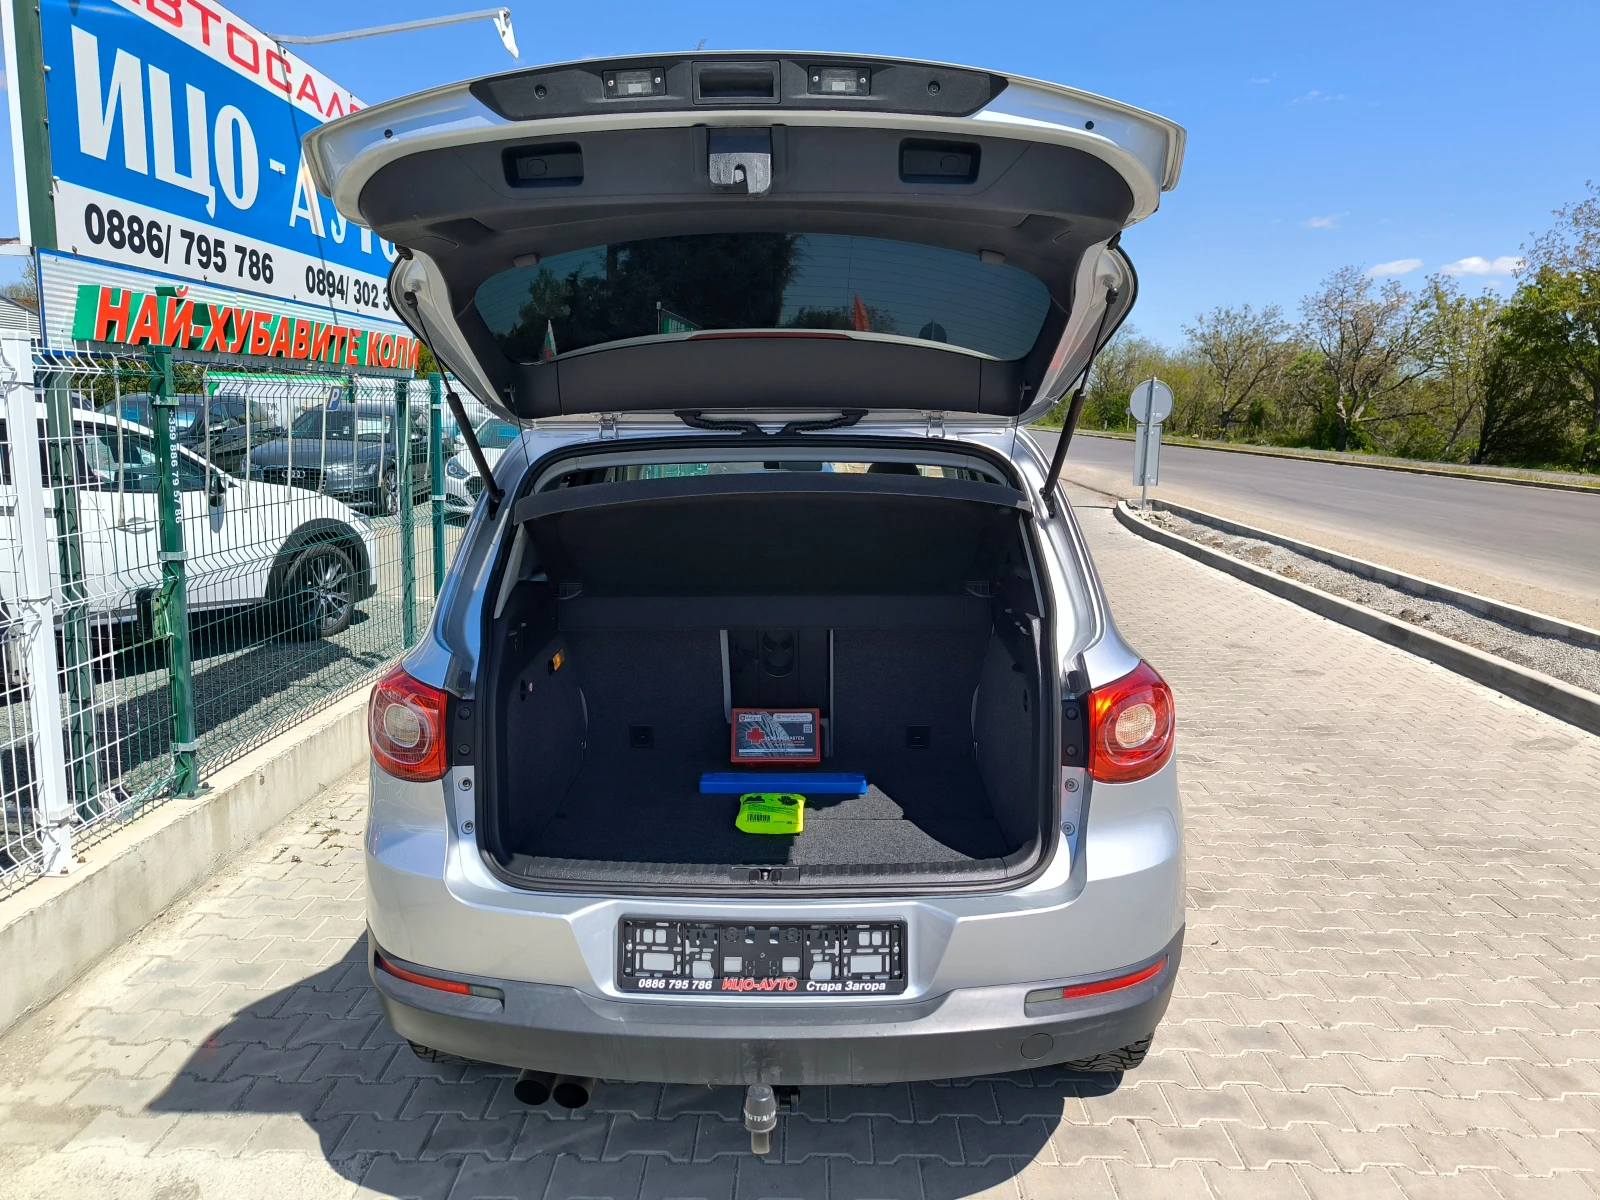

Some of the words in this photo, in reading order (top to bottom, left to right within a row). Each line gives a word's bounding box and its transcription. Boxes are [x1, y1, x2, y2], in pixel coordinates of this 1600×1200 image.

[132, 0, 361, 118] ВТОСАЛ
[84, 203, 172, 265] 0886/
[180, 228, 227, 273] 795
[234, 244, 274, 285] 786
[305, 265, 350, 305] 0894/
[353, 278, 379, 309] 302
[94, 286, 361, 366] НАЙ-ХУБАВИТЕ
[365, 331, 420, 370] КОЛИ
[168, 410, 177, 440] +359
[169, 444, 178, 467] 886
[172, 471, 180, 486] 79
[173, 490, 182, 505] 57
[174, 508, 182, 524] 86
[638, 978, 666, 989] 0886
[668, 979, 690, 990] 795
[692, 980, 713, 990] 786
[721, 977, 798, 992] ИЦО-АУТО
[806, 981, 842, 992] Стара
[845, 980, 886, 992] Загора
